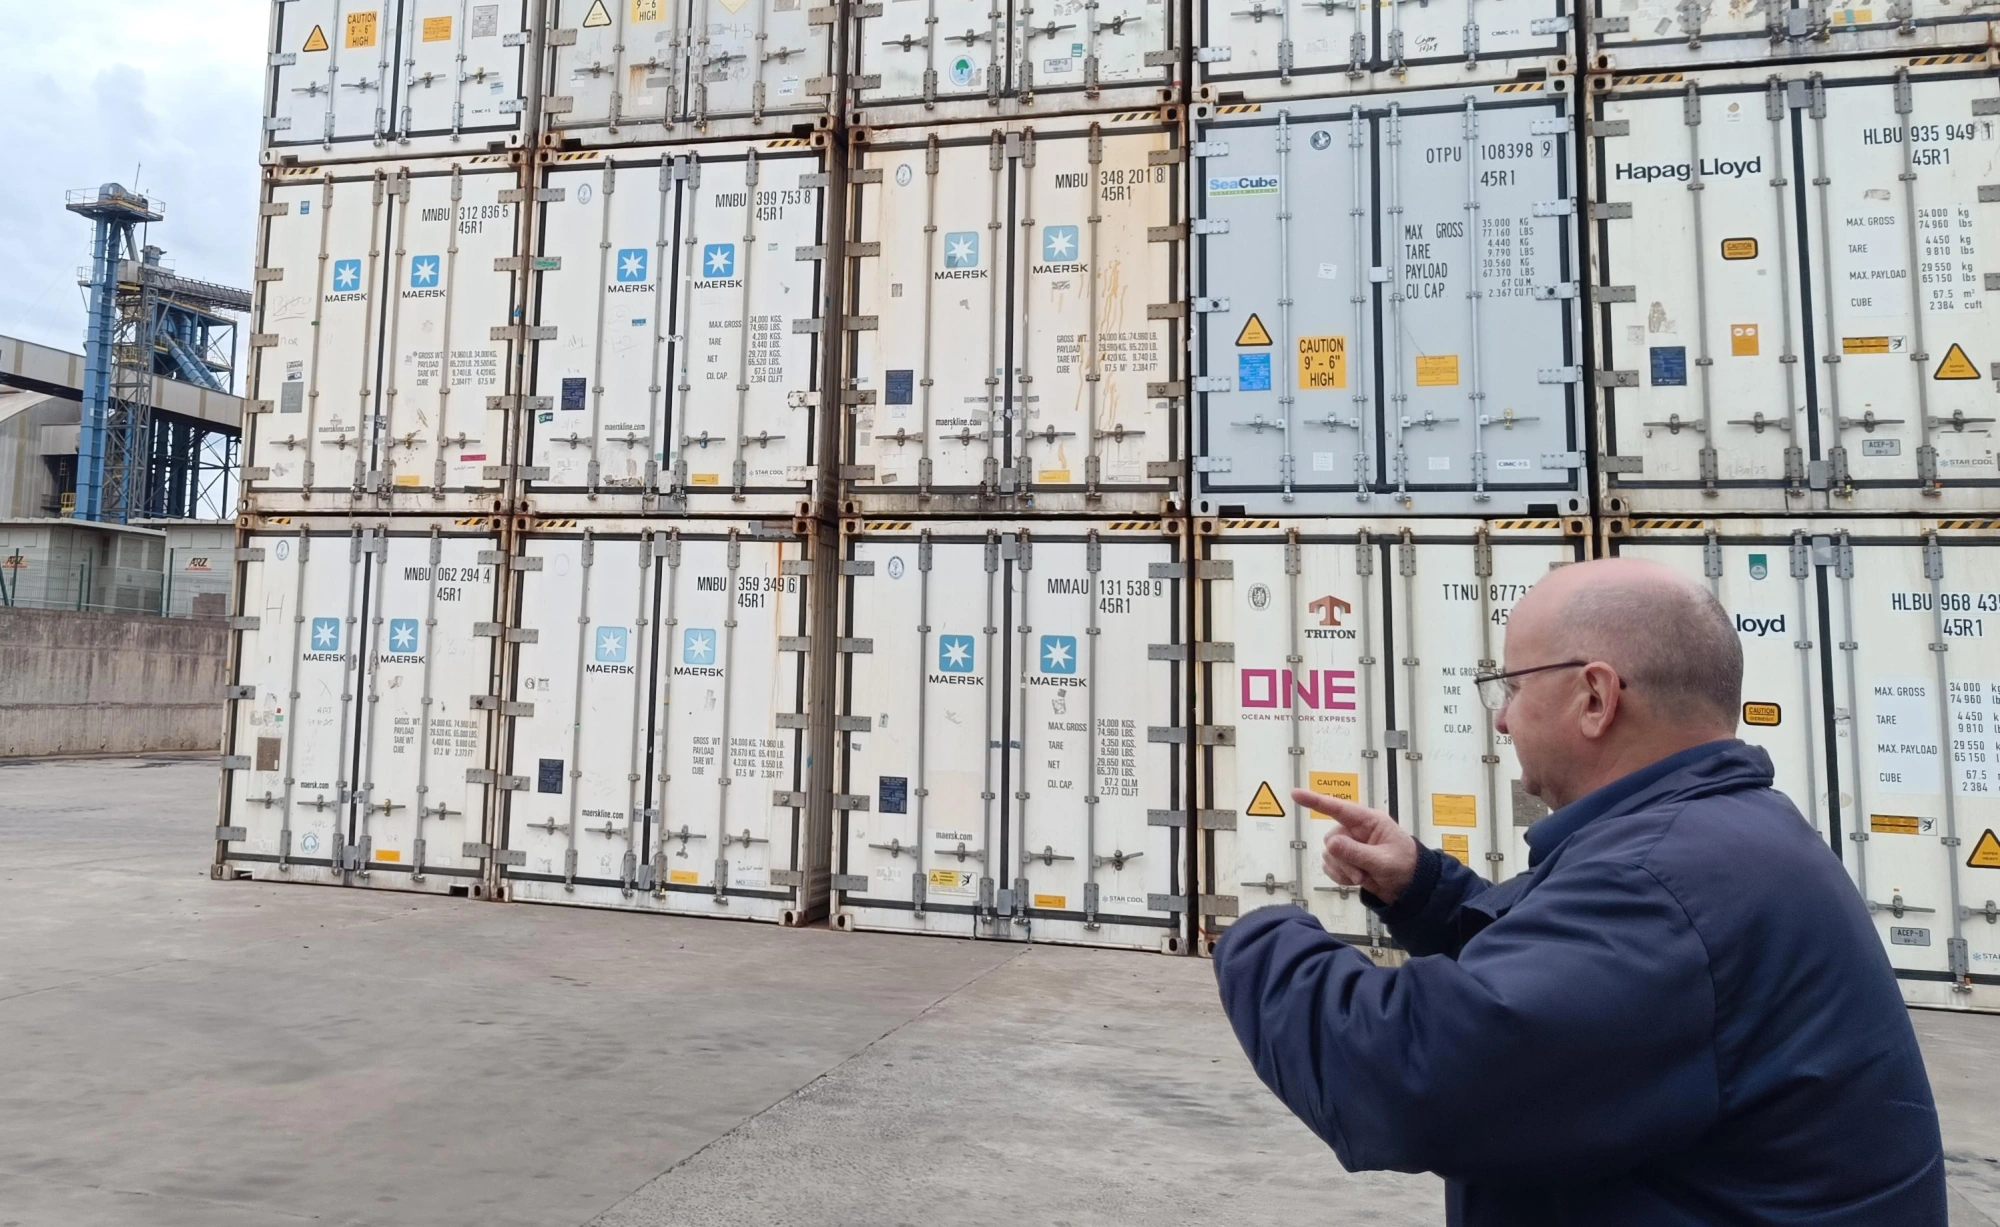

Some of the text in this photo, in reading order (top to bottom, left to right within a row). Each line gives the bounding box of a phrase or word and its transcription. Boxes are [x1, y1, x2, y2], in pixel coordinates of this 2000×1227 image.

[348, 13, 376, 24] CAUTION
[639, 11, 656, 21] HIGH
[353, 36, 368, 46] HIGH
[1864, 123, 1991, 145] HLBU 935 949 1
[1427, 140, 1551, 164] OTPU 108398 9
[1912, 149, 1950, 166] 45R1
[1700, 156, 1761, 178] Lloyd
[1055, 168, 1163, 189] MNBU 348 201 8
[1481, 170, 1515, 186] 45R1
[1210, 177, 1277, 190] SeaCube
[716, 190, 811, 207] MNBU 399 753 8
[1101, 186, 1131, 201] 45R1
[422, 205, 509, 221] MNBU 312 836 5
[756, 207, 783, 221] 45R1
[1958, 208, 1969, 218] kg
[1520, 218, 1528, 226] KG
[1868, 217, 1895, 225] GROSS
[1959, 219, 1972, 227] lbs
[458, 222, 483, 234] 45R1
[1405, 222, 1463, 240] MAX GROSS
[1520, 227, 1533, 236] LBS
[1520, 238, 1529, 246] KG
[1960, 235, 1971, 245] kg
[1405, 243, 1430, 259] TARE
[1520, 248, 1534, 256] LBS
[1849, 244, 1867, 253] TARE
[1961, 246, 1974, 254] lbs
[1520, 258, 1529, 266] KG
[1962, 262, 1973, 272] kg
[1033, 264, 1088, 274] MAERSK
[1406, 263, 1447, 279] PAYLOAD
[1521, 268, 1534, 276] LBS
[935, 269, 988, 280] MAERSK
[1871, 270, 1906, 279] PAYLOAD
[1963, 273, 1976, 281] lbs
[694, 280, 742, 289] MAERSK
[1502, 279, 1511, 287] 67
[402, 289, 446, 298] MAERSK
[608, 284, 654, 293] MAERSK
[325, 293, 368, 302] MAERSK
[1851, 298, 1872, 307] CUBE
[1965, 300, 1982, 309] cuft
[725, 320, 742, 328] GROSS
[1057, 335, 1074, 343] GROSS
[1057, 345, 1080, 353] PAYLOAD
[1300, 338, 1344, 353] CAUTION
[1057, 365, 1070, 373] CUBE
[1310, 372, 1334, 387] HIGH
[605, 423, 645, 431] maerskline.com
[404, 567, 490, 582] MNBU 062 294 4
[697, 577, 795, 592] MNBU 359 349 6
[1048, 579, 1162, 596] MMAU 131 538 9
[437, 587, 461, 601] 45R1
[1443, 584, 1534, 601] TTNU 8773
[738, 593, 764, 608] 45R1
[1099, 598, 1131, 613] 45R1
[1892, 593, 2000, 611] HLBU 968 43
[1736, 614, 1786, 636] loyd
[1944, 619, 1982, 636] 45R1
[1305, 629, 1356, 639] TRITON
[303, 654, 346, 662] MAERSK
[380, 655, 425, 664] MAERSK
[586, 664, 634, 674] MAERSK
[674, 667, 723, 677] MAERSK
[1442, 668, 1481, 676] MAX GROSS
[929, 675, 984, 686] MAERSK
[1030, 677, 1087, 688] MAERSK
[1242, 669, 1356, 710] ONE
[1443, 686, 1461, 695] TARE
[1897, 687, 1925, 697] GROSS
[1444, 705, 1457, 714] NET
[1877, 715, 1897, 725] TARE
[1067, 723, 1087, 731] GROSS
[1049, 741, 1064, 749] TARE
[1901, 744, 1937, 754] PAYLOAD
[693, 747, 714, 755] PAYLOAD
[1048, 760, 1060, 769] NET
[1880, 773, 1902, 782] CUBE
[300, 781, 329, 789] maersk.com
[582, 809, 624, 820] maerskline.com
[936, 831, 973, 841] maersk.com
